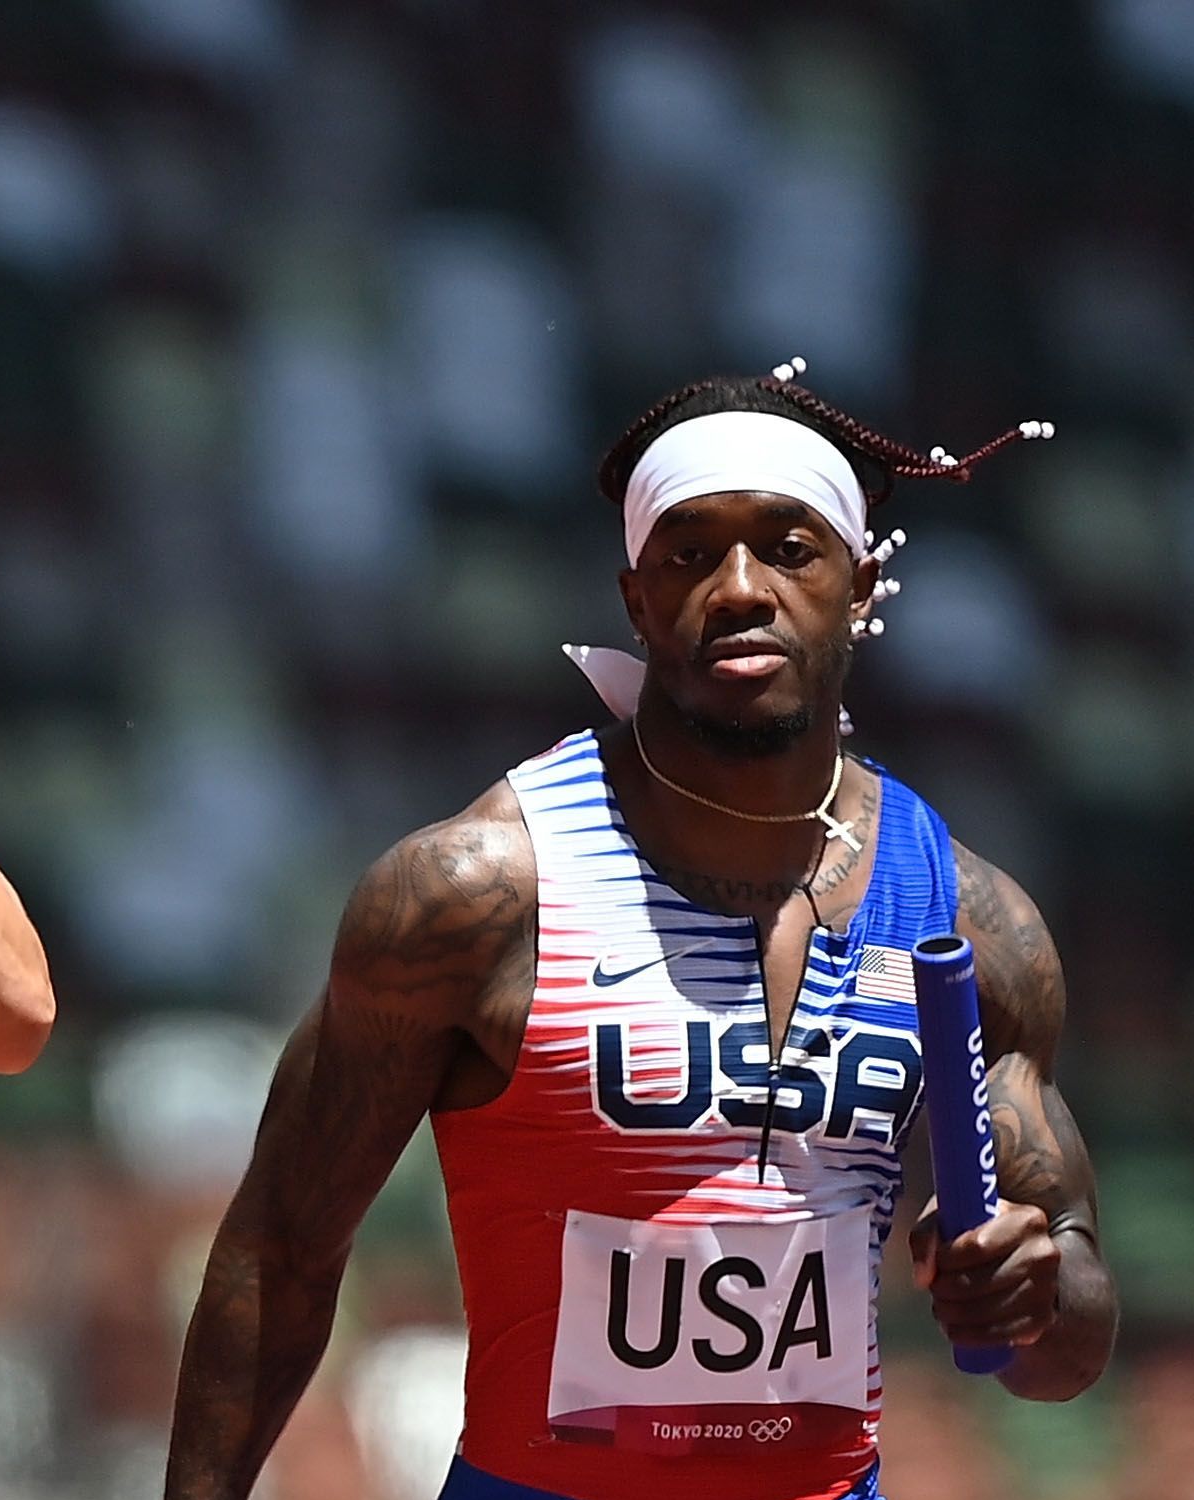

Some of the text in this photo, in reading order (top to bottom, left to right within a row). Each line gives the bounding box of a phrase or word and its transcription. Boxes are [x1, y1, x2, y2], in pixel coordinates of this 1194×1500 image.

[590, 1021, 925, 1145] USA
[606, 1250, 833, 1371] USA
[652, 1422, 744, 1439] TOKYO 2020
